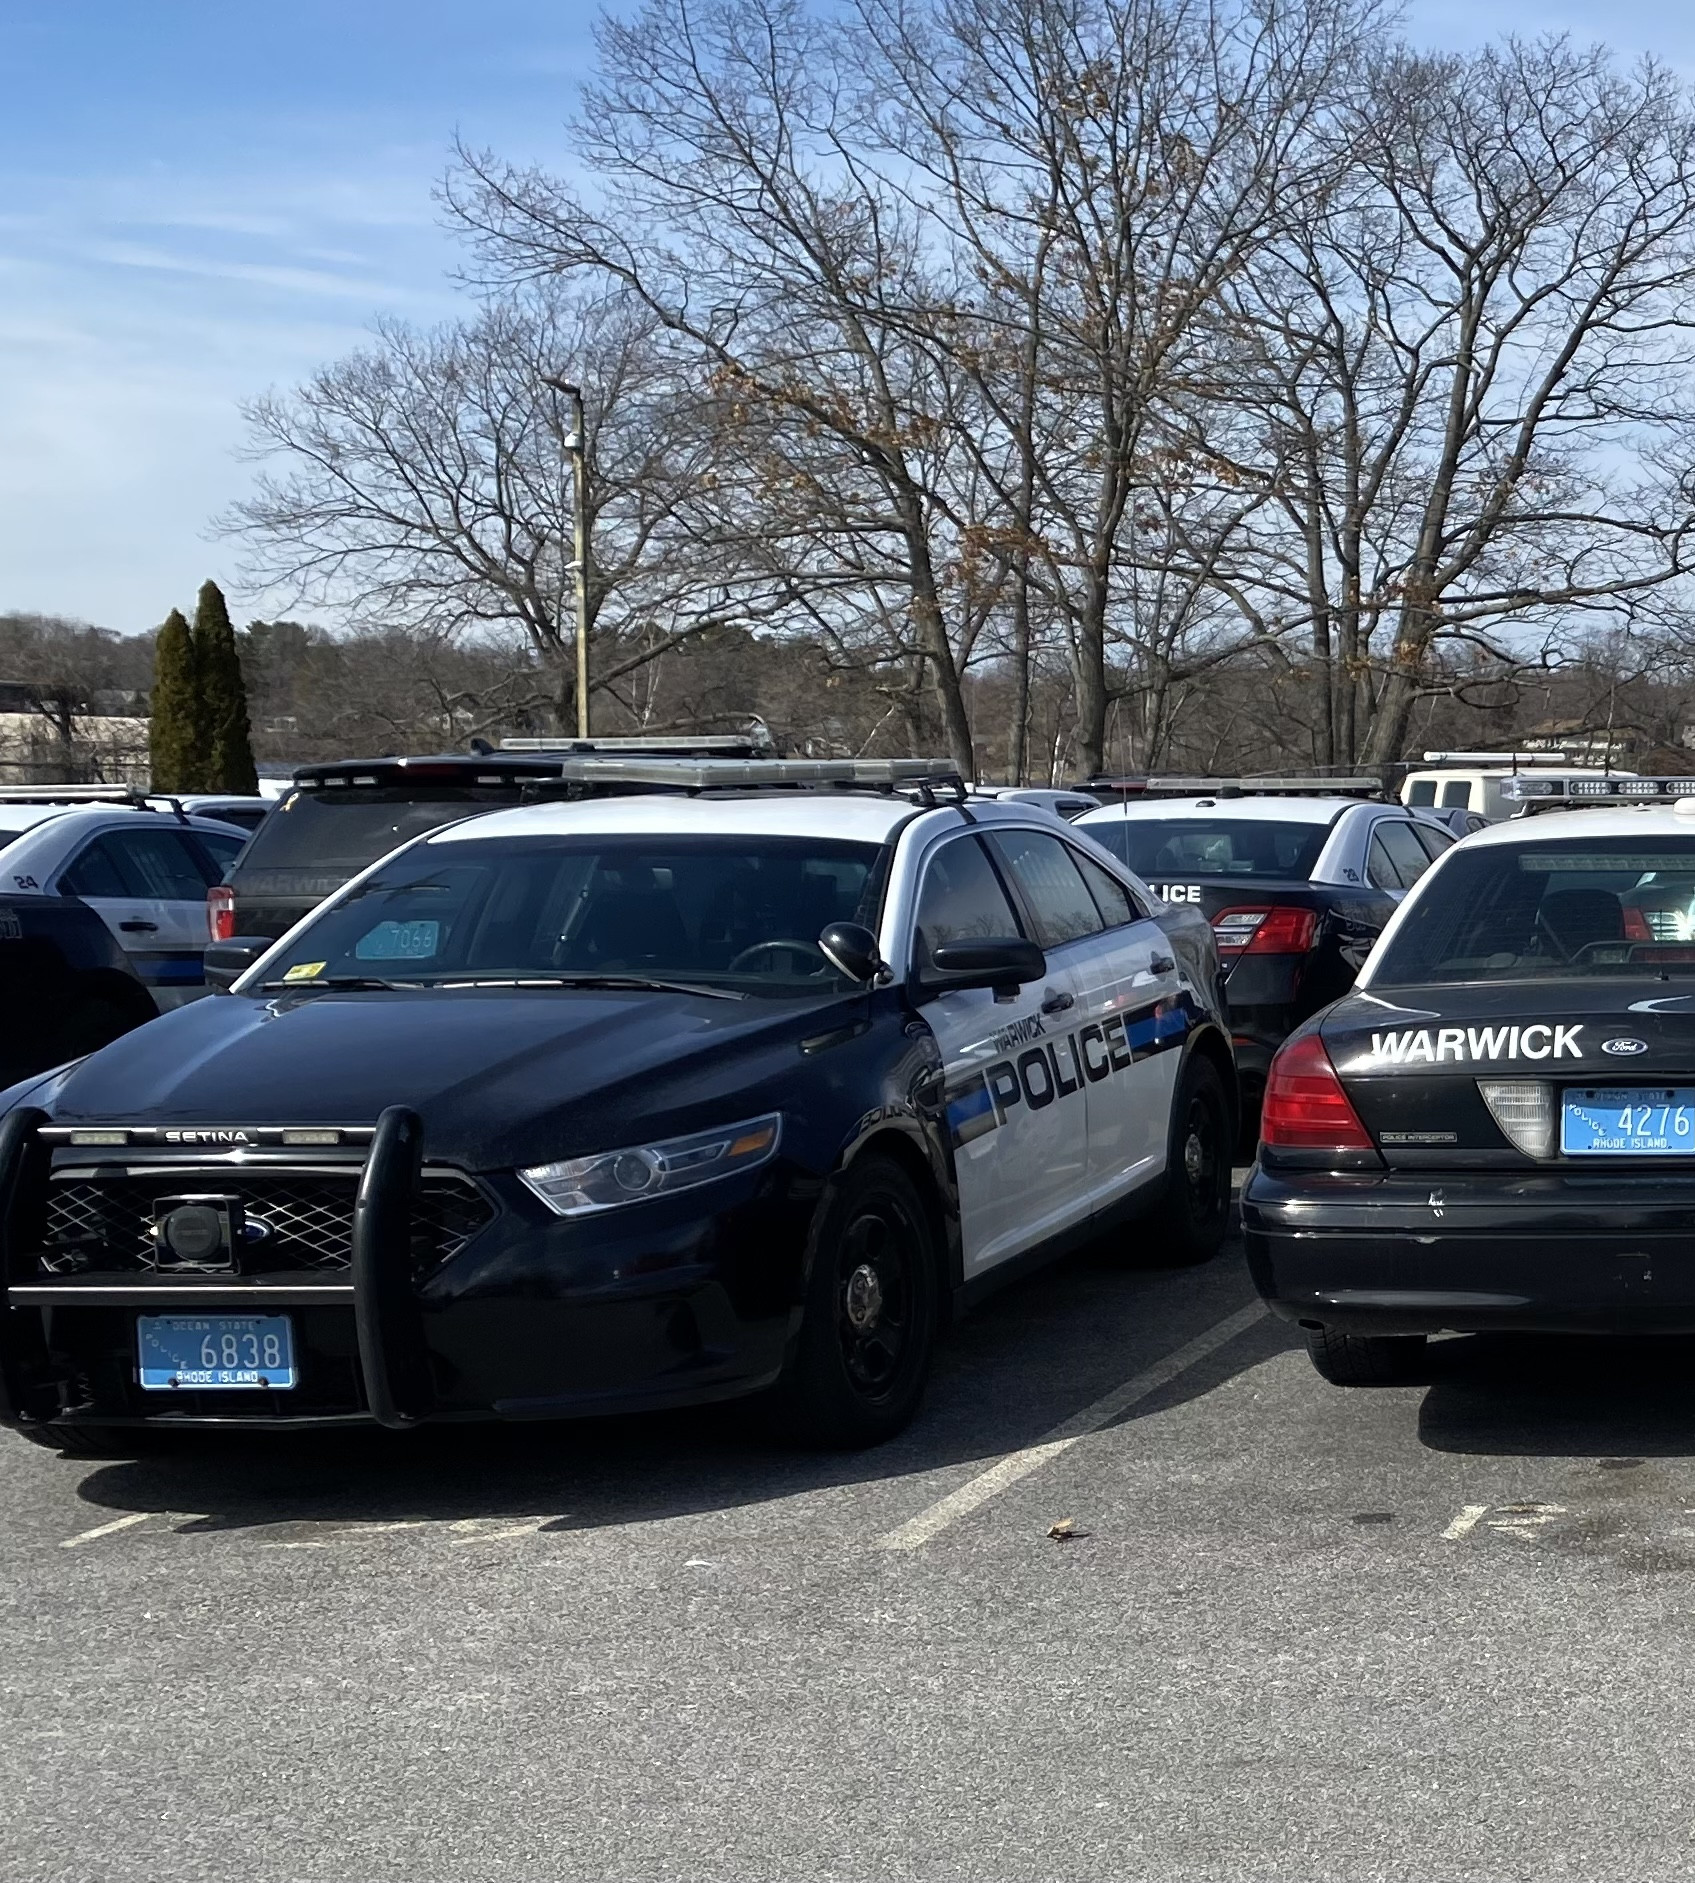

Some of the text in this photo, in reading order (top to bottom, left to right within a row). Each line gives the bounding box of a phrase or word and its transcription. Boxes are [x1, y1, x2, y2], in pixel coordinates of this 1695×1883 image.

[13, 875, 39, 889] 24
[989, 1013, 1046, 1053] WARWICK
[1371, 1023, 1584, 1062] WARWICK
[1611, 1040, 1638, 1052] Ford
[985, 1013, 1132, 1126] POLICE
[1617, 1104, 1690, 1136] 4276
[165, 1131, 249, 1142] SETINA
[1592, 1138, 1668, 1149] RHODE ISLAND
[172, 1321, 255, 1330] OCEAN STATE
[146, 1333, 188, 1369] POLICE
[201, 1333, 281, 1369] 6838
[176, 1371, 259, 1383] RHODE ISLAND
